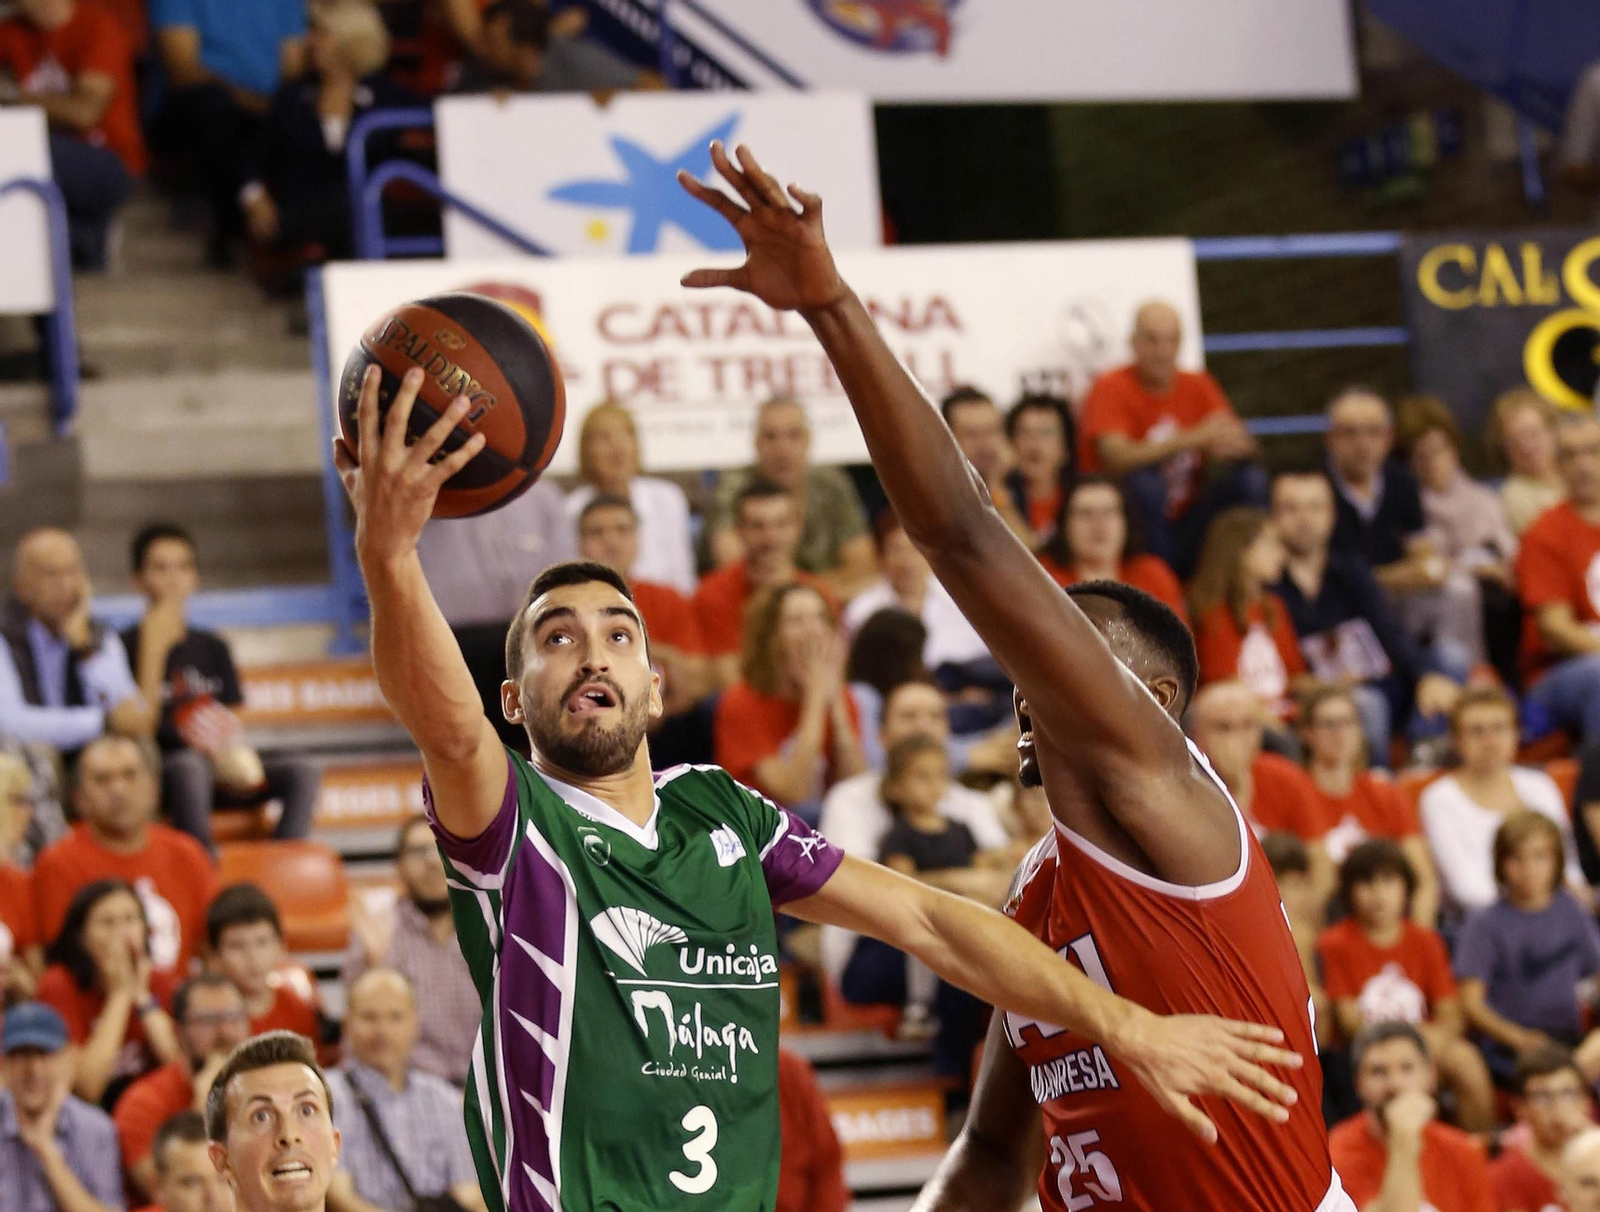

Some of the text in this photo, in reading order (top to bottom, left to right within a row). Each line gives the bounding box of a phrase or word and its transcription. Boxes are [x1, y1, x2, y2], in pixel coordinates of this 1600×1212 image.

[597, 298, 965, 344] CATALNA
[679, 943, 778, 983] Unicaja
[641, 1061, 687, 1079] Ciudad
[668, 1105, 719, 1195] 3
